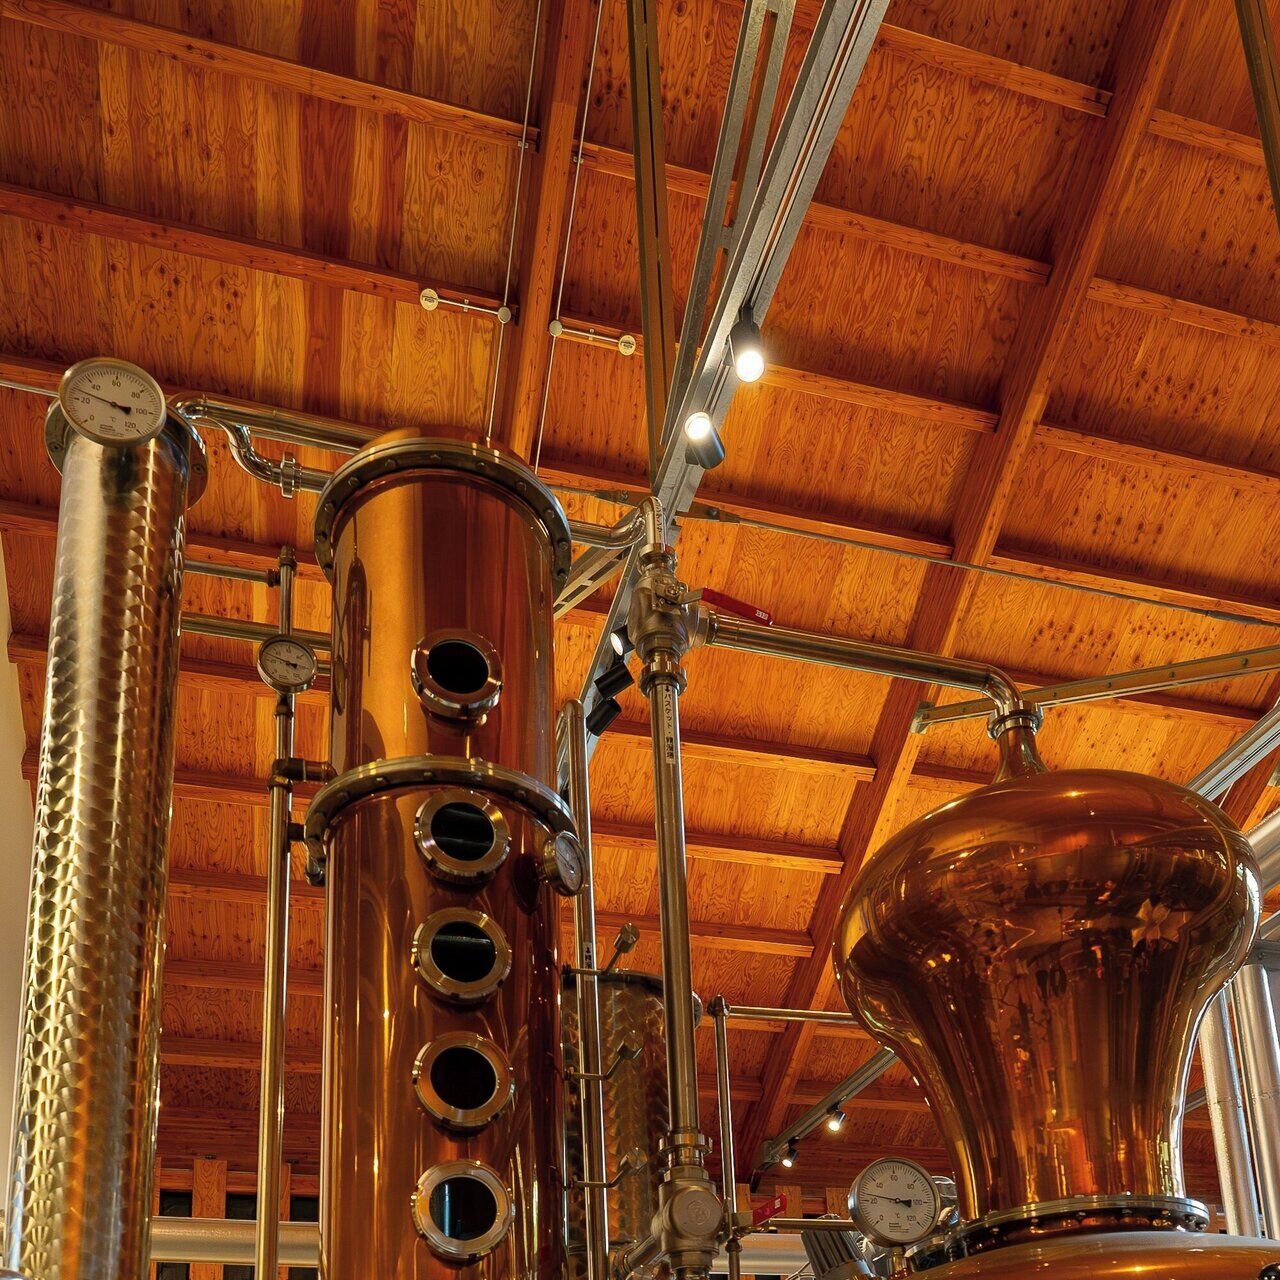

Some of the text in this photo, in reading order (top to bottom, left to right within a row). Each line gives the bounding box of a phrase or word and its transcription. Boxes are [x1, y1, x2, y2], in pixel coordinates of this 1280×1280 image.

[91, 383, 101, 391] 40
[131, 391, 140, 399] 80
[125, 421, 136, 429] 120
